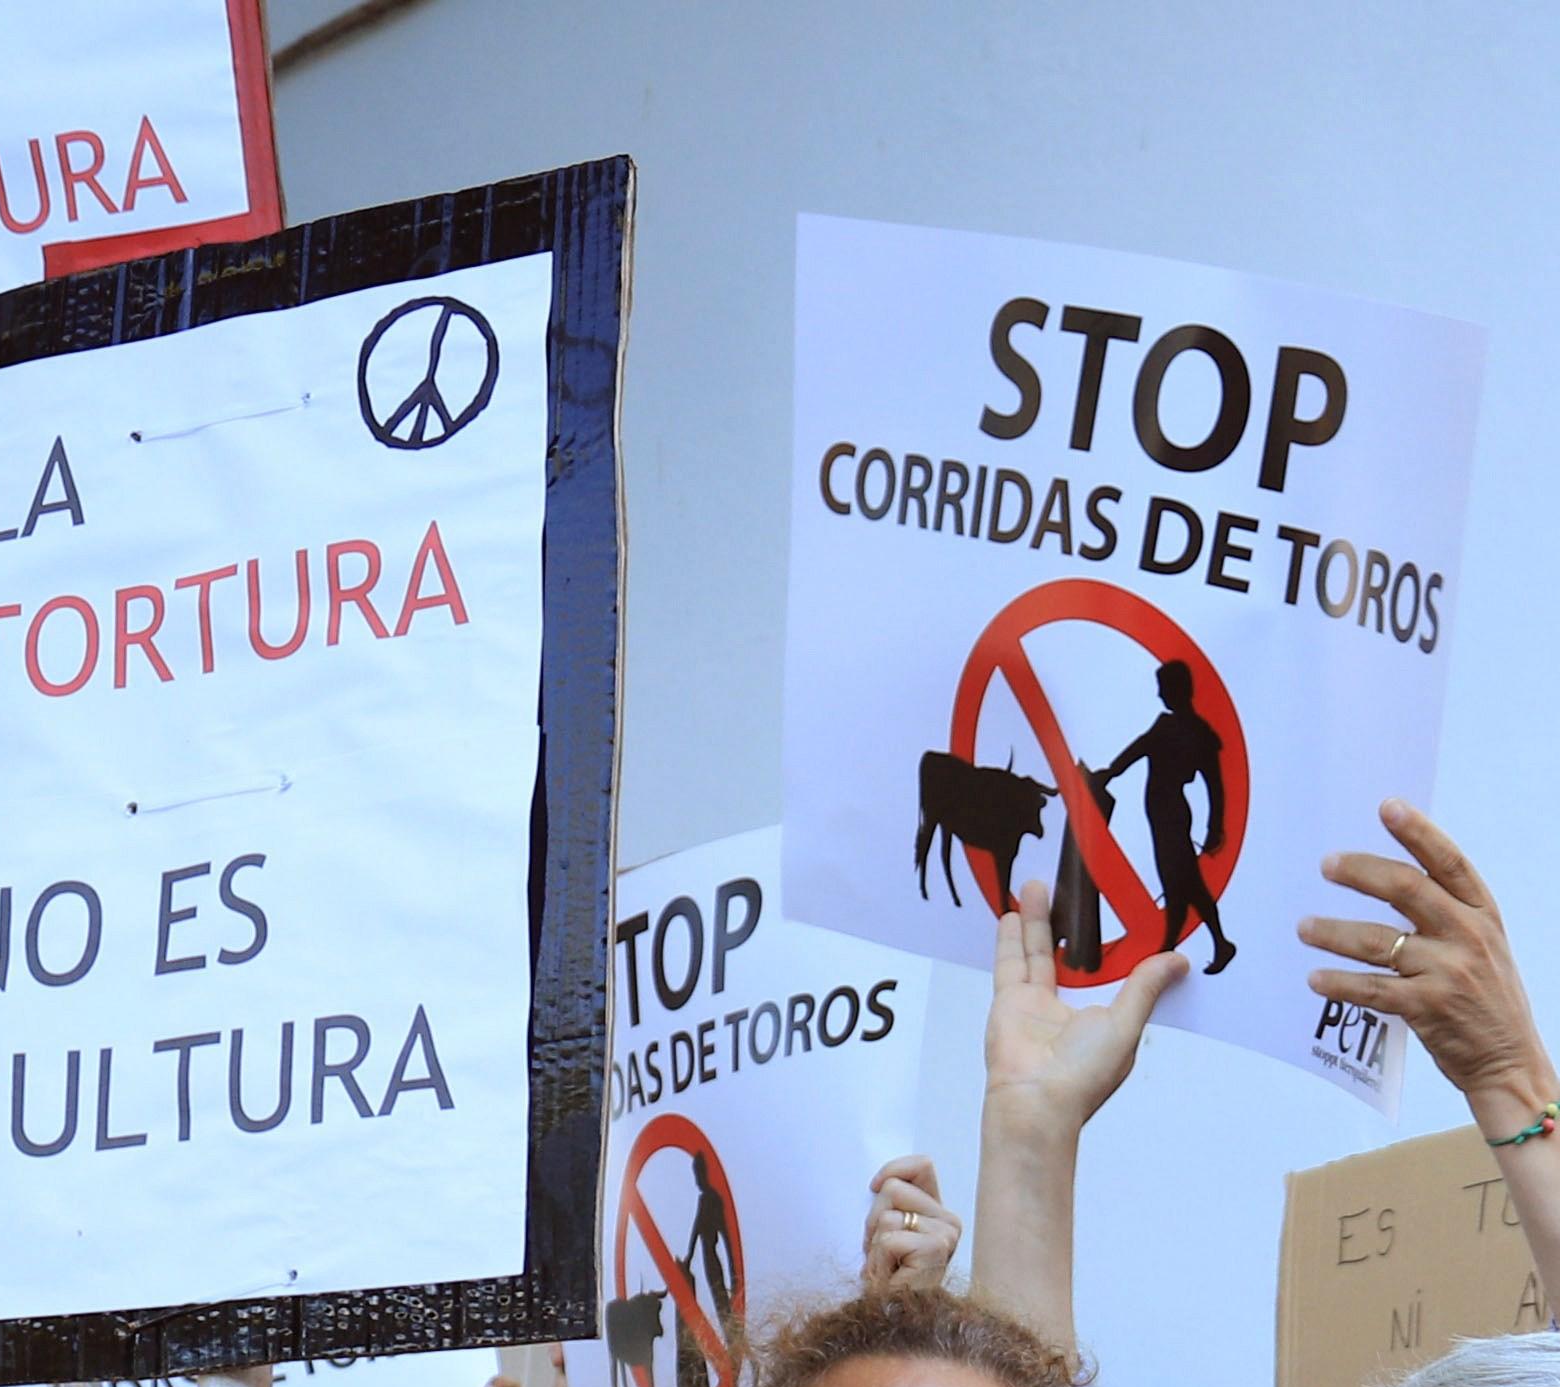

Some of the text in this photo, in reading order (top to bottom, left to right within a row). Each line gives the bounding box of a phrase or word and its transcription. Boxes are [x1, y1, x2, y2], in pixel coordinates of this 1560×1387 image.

[978, 296, 1349, 494] STOP
[818, 441, 1444, 655] CORRIDAS DE TOROS
[153, 852, 269, 976] ES
[615, 876, 763, 1027] TOP
[669, 1020, 718, 1095] DE
[724, 979, 898, 1073] TOROS
[1336, 1206, 1397, 1267] ES
